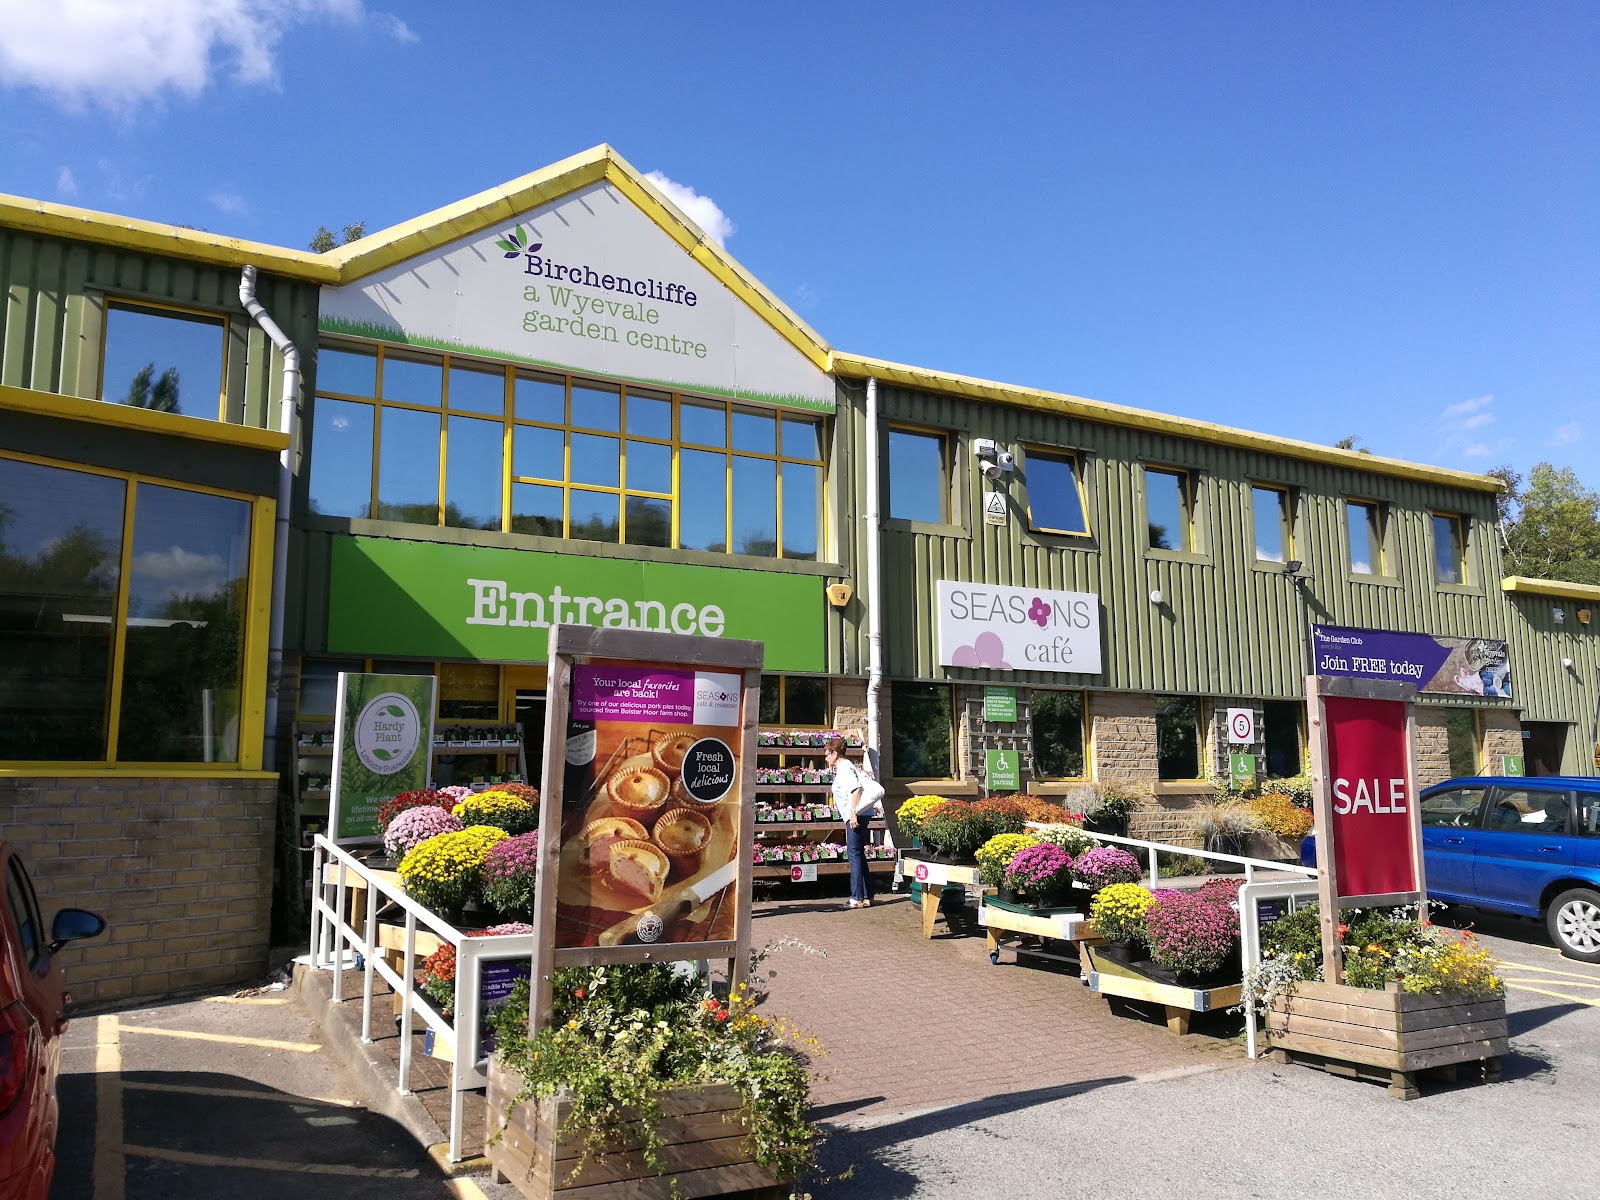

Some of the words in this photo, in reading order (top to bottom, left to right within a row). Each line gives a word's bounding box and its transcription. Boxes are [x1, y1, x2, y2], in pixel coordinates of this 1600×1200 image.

[524, 253, 698, 307] Birchencliffe
[523, 284, 540, 302] a
[547, 284, 660, 324] Wyevale
[522, 310, 618, 343] garden
[626, 328, 708, 358] centre
[466, 578, 725, 638] Entrance
[1330, 635, 1350, 644] Garden
[1024, 636, 1072, 664] café
[1321, 654, 1349, 671] Join
[1352, 656, 1386, 674] FREE
[1389, 660, 1424, 679] today
[592, 678, 616, 688] Your
[618, 678, 641, 688] local
[642, 679, 680, 691] favorites
[632, 689, 658, 698] back!
[374, 722, 405, 732] Hardy
[1239, 720, 1244, 731] 5
[375, 733, 402, 742] Plant
[360, 750, 382, 772] Lifetime
[383, 750, 413, 772] Guarantee
[696, 752, 723, 761] Fresh
[698, 762, 720, 772] local
[690, 774, 728, 788] delicious
[1333, 778, 1407, 815] SALE
